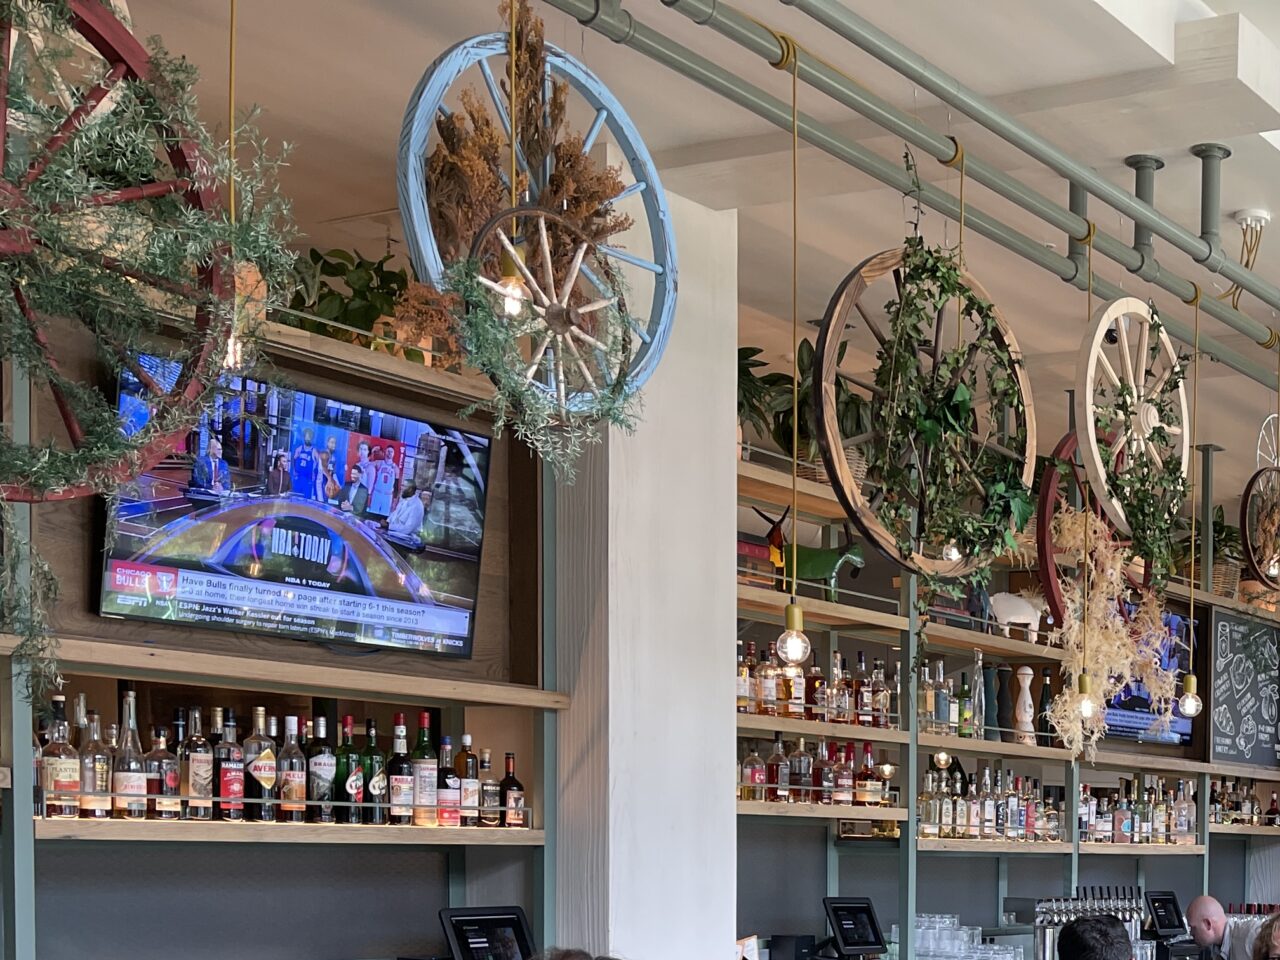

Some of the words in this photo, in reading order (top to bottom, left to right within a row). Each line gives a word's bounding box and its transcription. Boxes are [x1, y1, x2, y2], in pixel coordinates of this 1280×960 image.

[271, 527, 292, 556] NBA
[299, 532, 331, 565] TODAY
[116, 567, 152, 578] CHICAGO
[115, 574, 147, 587] BULLS
[285, 576, 300, 584] NBA
[308, 579, 331, 588] TODAY
[116, 594, 148, 607] ESPN
[182, 575, 204, 587] Have
[206, 579, 227, 590] Bulls
[228, 582, 253, 594] finally
[255, 586, 281, 597] turned
[297, 593, 317, 603] page
[318, 595, 337, 604] after
[339, 599, 367, 610] starting
[368, 602, 380, 610] 6-1
[381, 603, 395, 613] this
[396, 607, 426, 617] season?
[204, 590, 228, 600] home,
[229, 592, 246, 602] their
[247, 594, 274, 605] longest
[274, 600, 295, 609] home
[309, 603, 330, 612] streak
[331, 606, 339, 614] to
[340, 609, 355, 617] start
[362, 611, 385, 621] season
[386, 614, 403, 622] since
[283, 614, 292, 622] for
[293, 617, 316, 625] season
